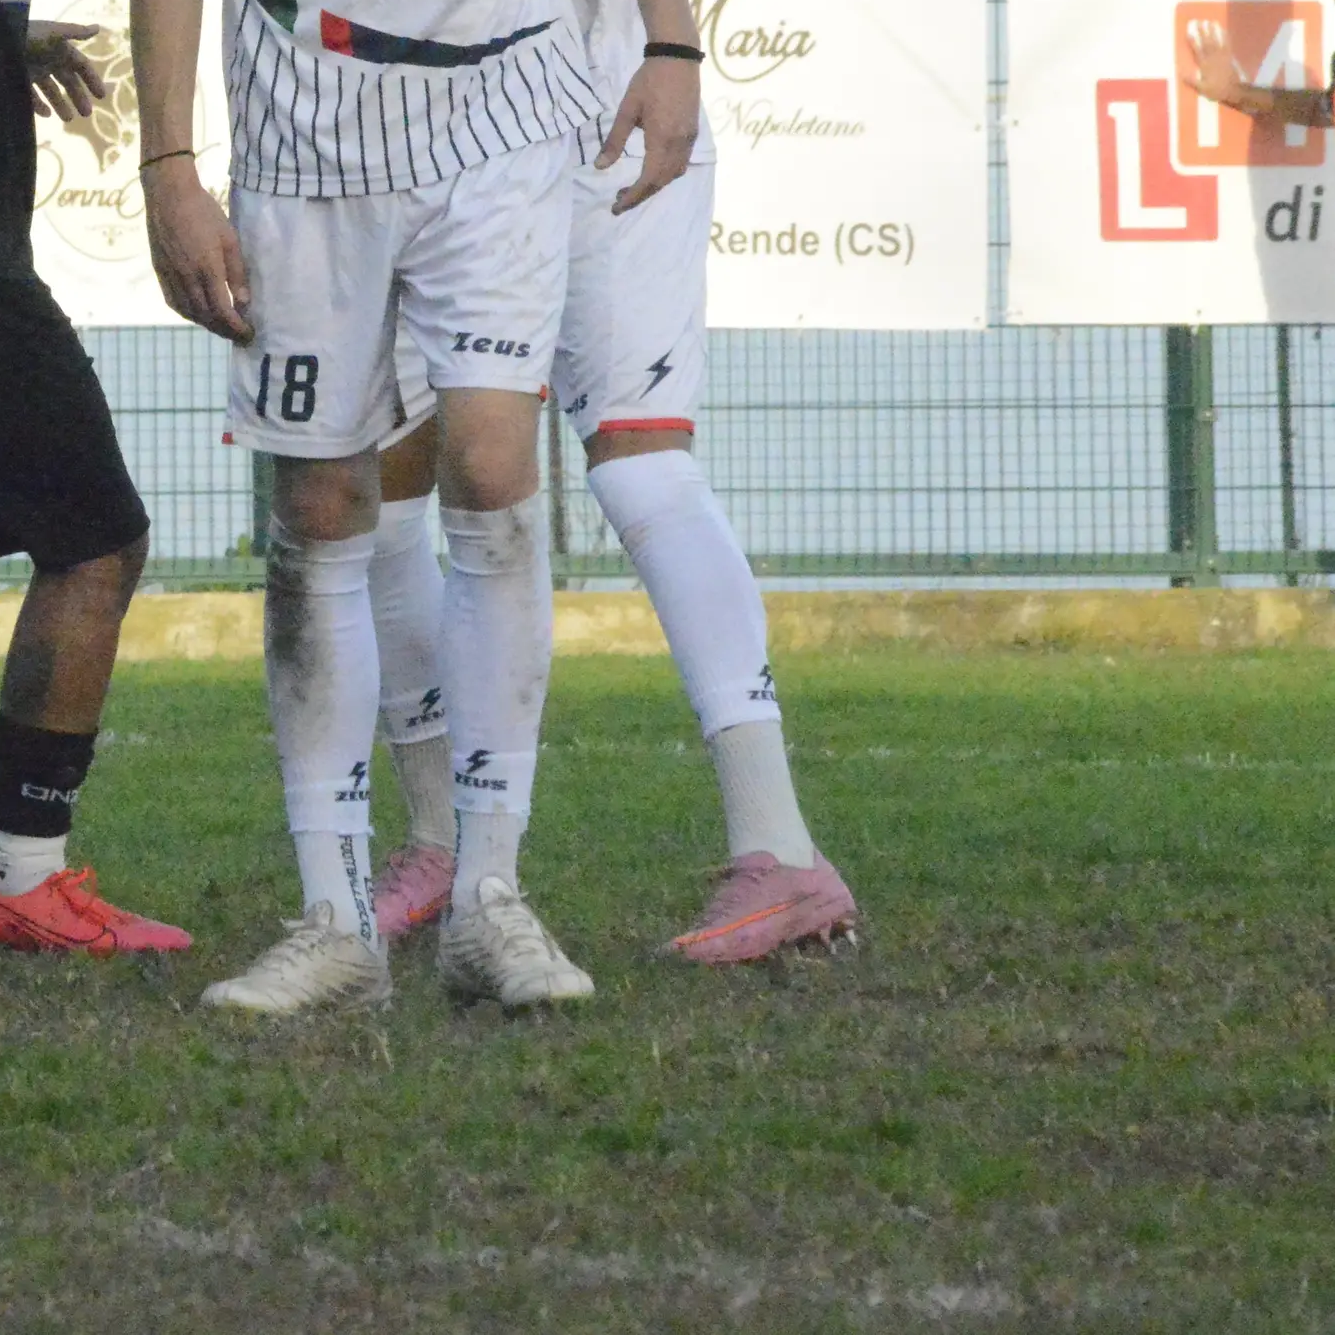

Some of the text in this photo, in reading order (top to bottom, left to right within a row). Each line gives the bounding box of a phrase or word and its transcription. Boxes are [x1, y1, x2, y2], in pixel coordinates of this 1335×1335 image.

[712, 96, 865, 151] Napoletano
[1265, 184, 1324, 243] di
[710, 221, 914, 266] Rende (CS)
[451, 331, 531, 358] Zeus
[255, 353, 319, 422] 18
